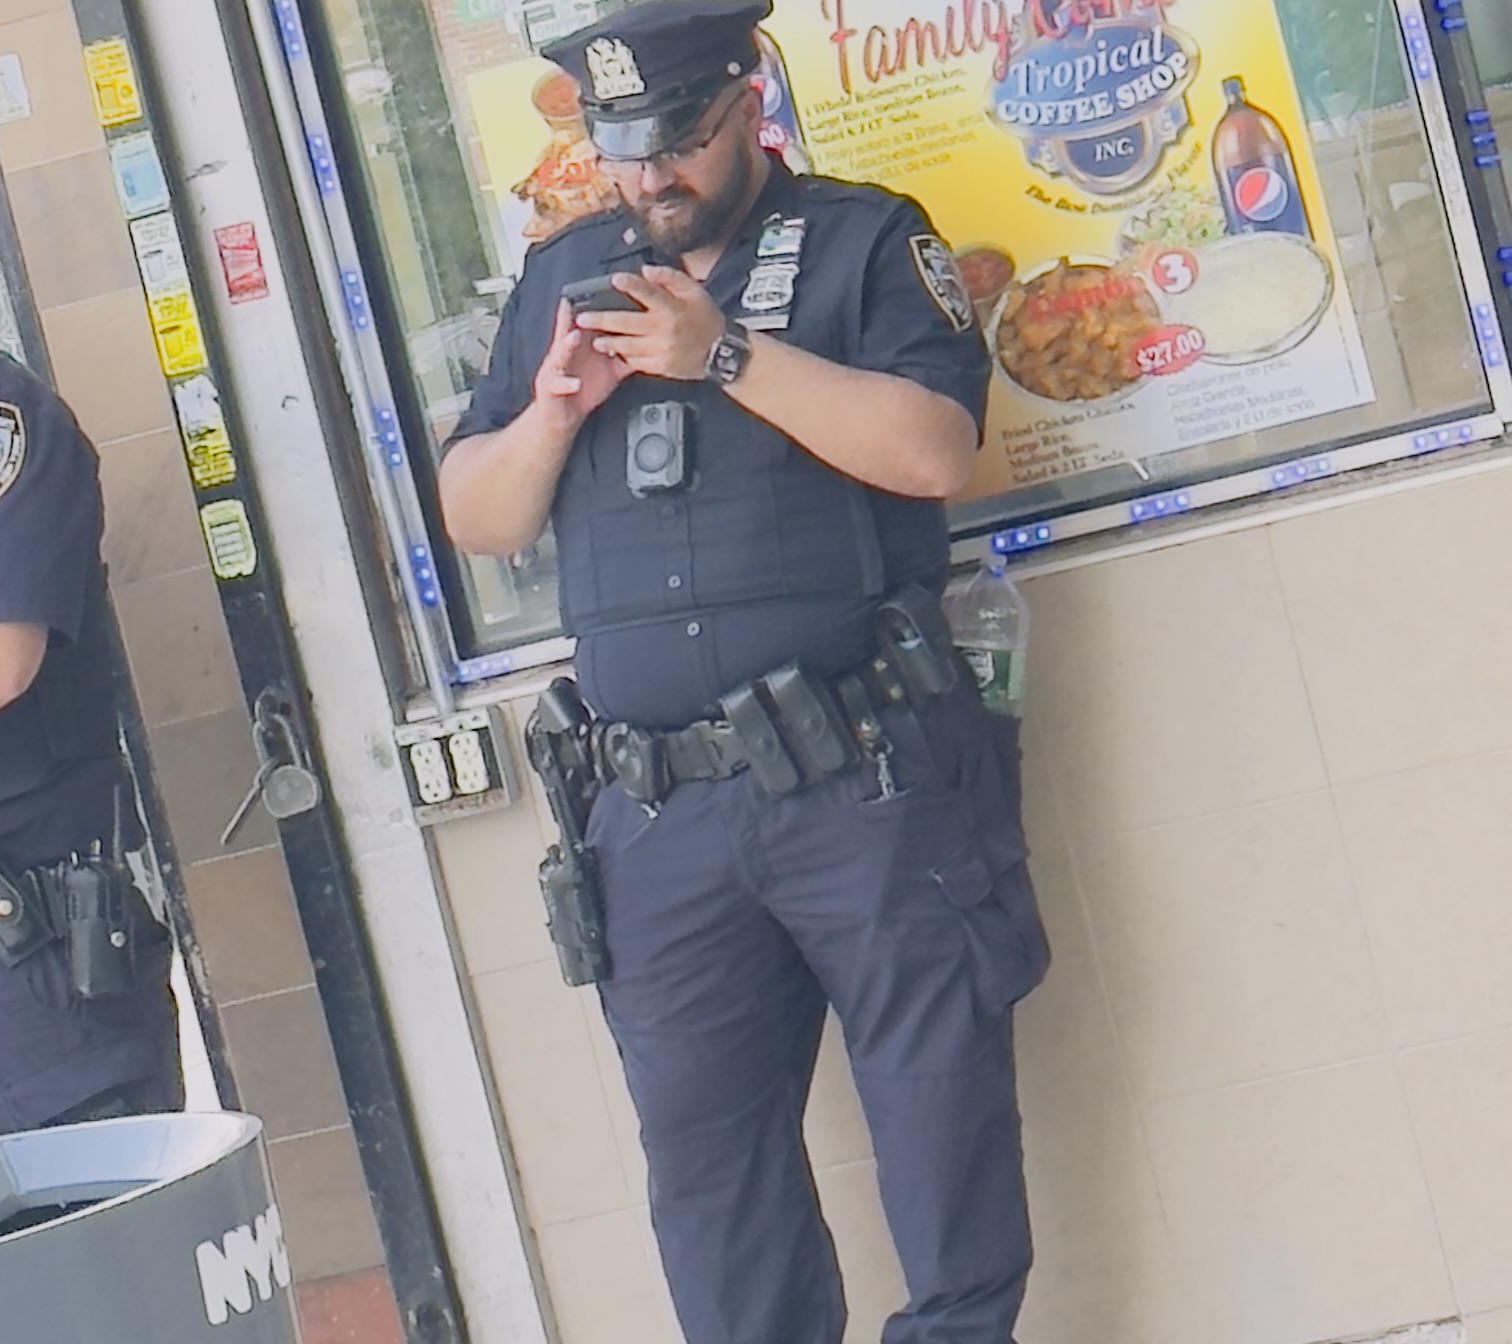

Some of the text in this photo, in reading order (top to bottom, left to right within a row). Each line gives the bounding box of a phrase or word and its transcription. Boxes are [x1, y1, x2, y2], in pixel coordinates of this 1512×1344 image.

[1009, 26, 1167, 98] Tropical
[996, 52, 1188, 126] COFFEE SHOP
[1094, 137, 1134, 162] INC.
[1158, 253, 1193, 294] 3
[1137, 329, 1203, 372] $27.00
